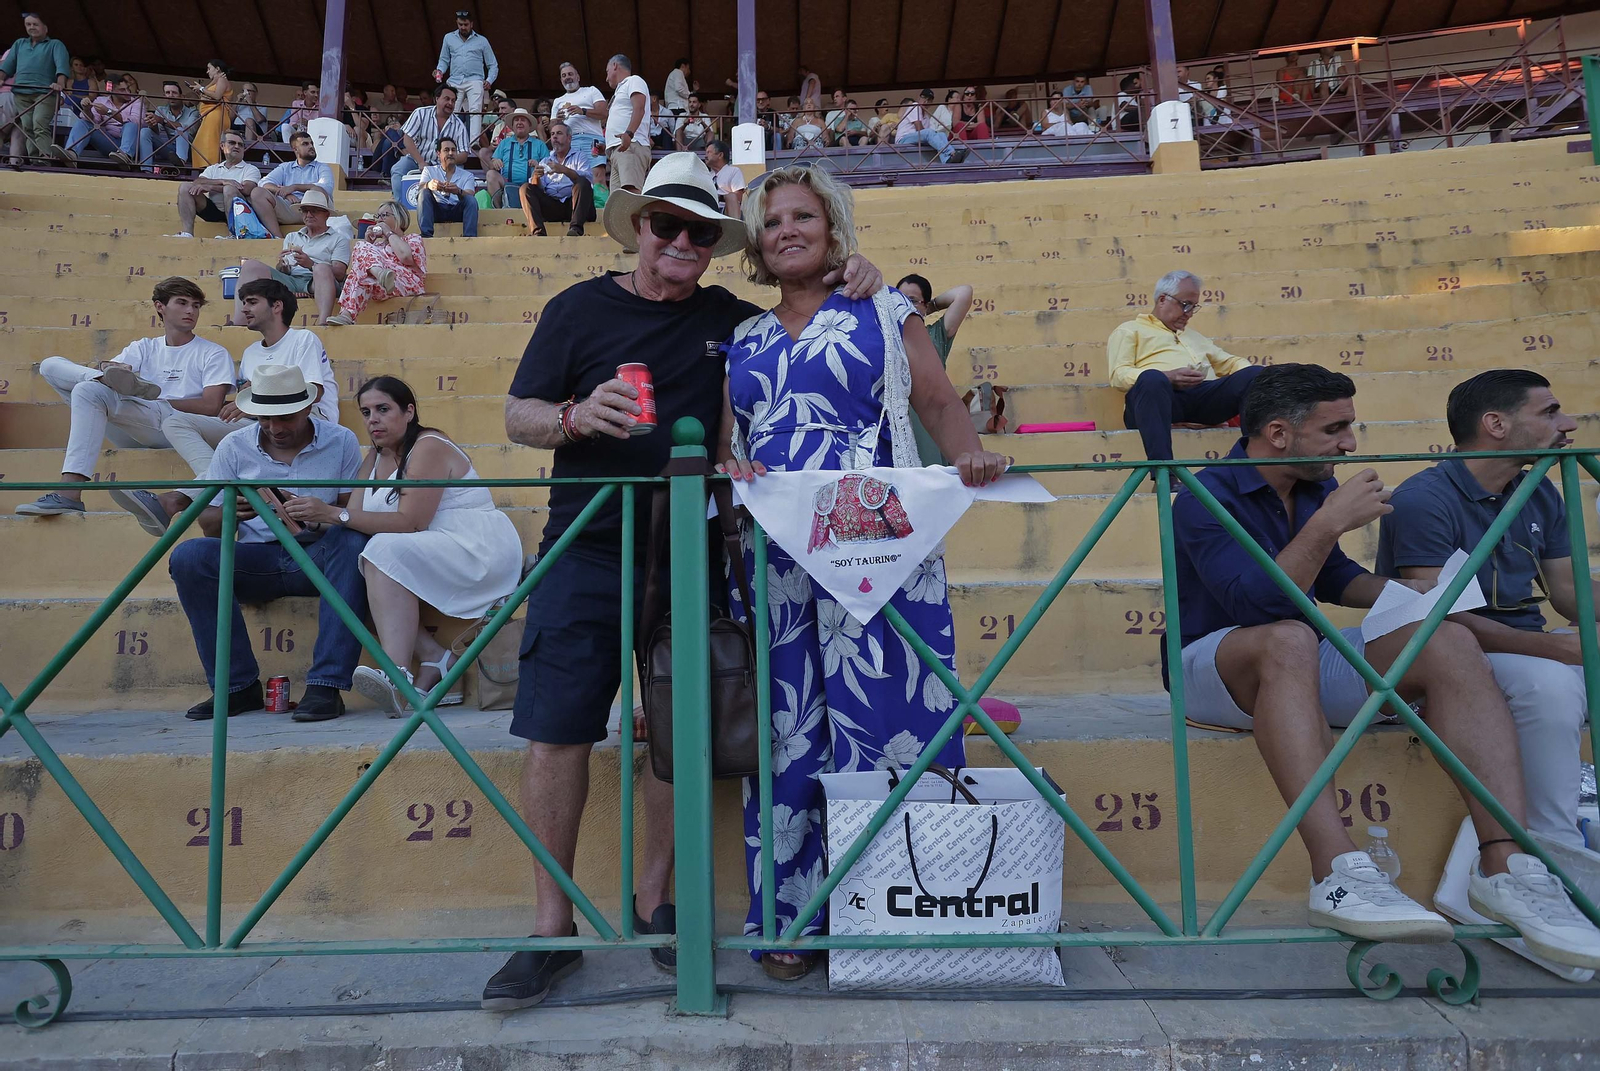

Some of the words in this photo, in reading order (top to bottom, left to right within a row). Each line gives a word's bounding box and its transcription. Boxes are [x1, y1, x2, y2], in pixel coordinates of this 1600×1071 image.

[1170, 119, 1179, 129] 7
[318, 136, 327, 146] 7
[744, 141, 753, 150] 7
[128, 266, 145, 276] 14
[1281, 285, 1303, 299] 30
[1349, 283, 1366, 296] 31
[1438, 276, 1461, 291] 32
[973, 298, 995, 312] 26
[1048, 298, 1070, 311] 27
[1126, 293, 1148, 307] 28
[1202, 290, 1225, 303] 29
[71, 313, 91, 327] 14
[1523, 334, 1553, 351] 29
[1339, 351, 1364, 366] 27
[1427, 346, 1453, 361] 28
[1063, 361, 1091, 377] 24
[436, 375, 458, 391] 17
[980, 614, 1015, 639] 21
[1125, 610, 1166, 635] 22
[115, 630, 148, 656] 15
[260, 627, 295, 652] 16
[827, 803, 849, 826] entral
[1094, 792, 1161, 831] 25
[1337, 783, 1391, 827] 26
[0, 812, 25, 850] 0
[186, 806, 244, 847] 21
[406, 800, 474, 842] 22
[910, 809, 935, 835] entral
[997, 811, 1020, 840] entral
[854, 839, 881, 865] entral
[992, 834, 1014, 860] entral
[870, 859, 897, 880] entral
[918, 851, 944, 876] entral
[985, 858, 1007, 881] entral
[887, 882, 1039, 918] Central
